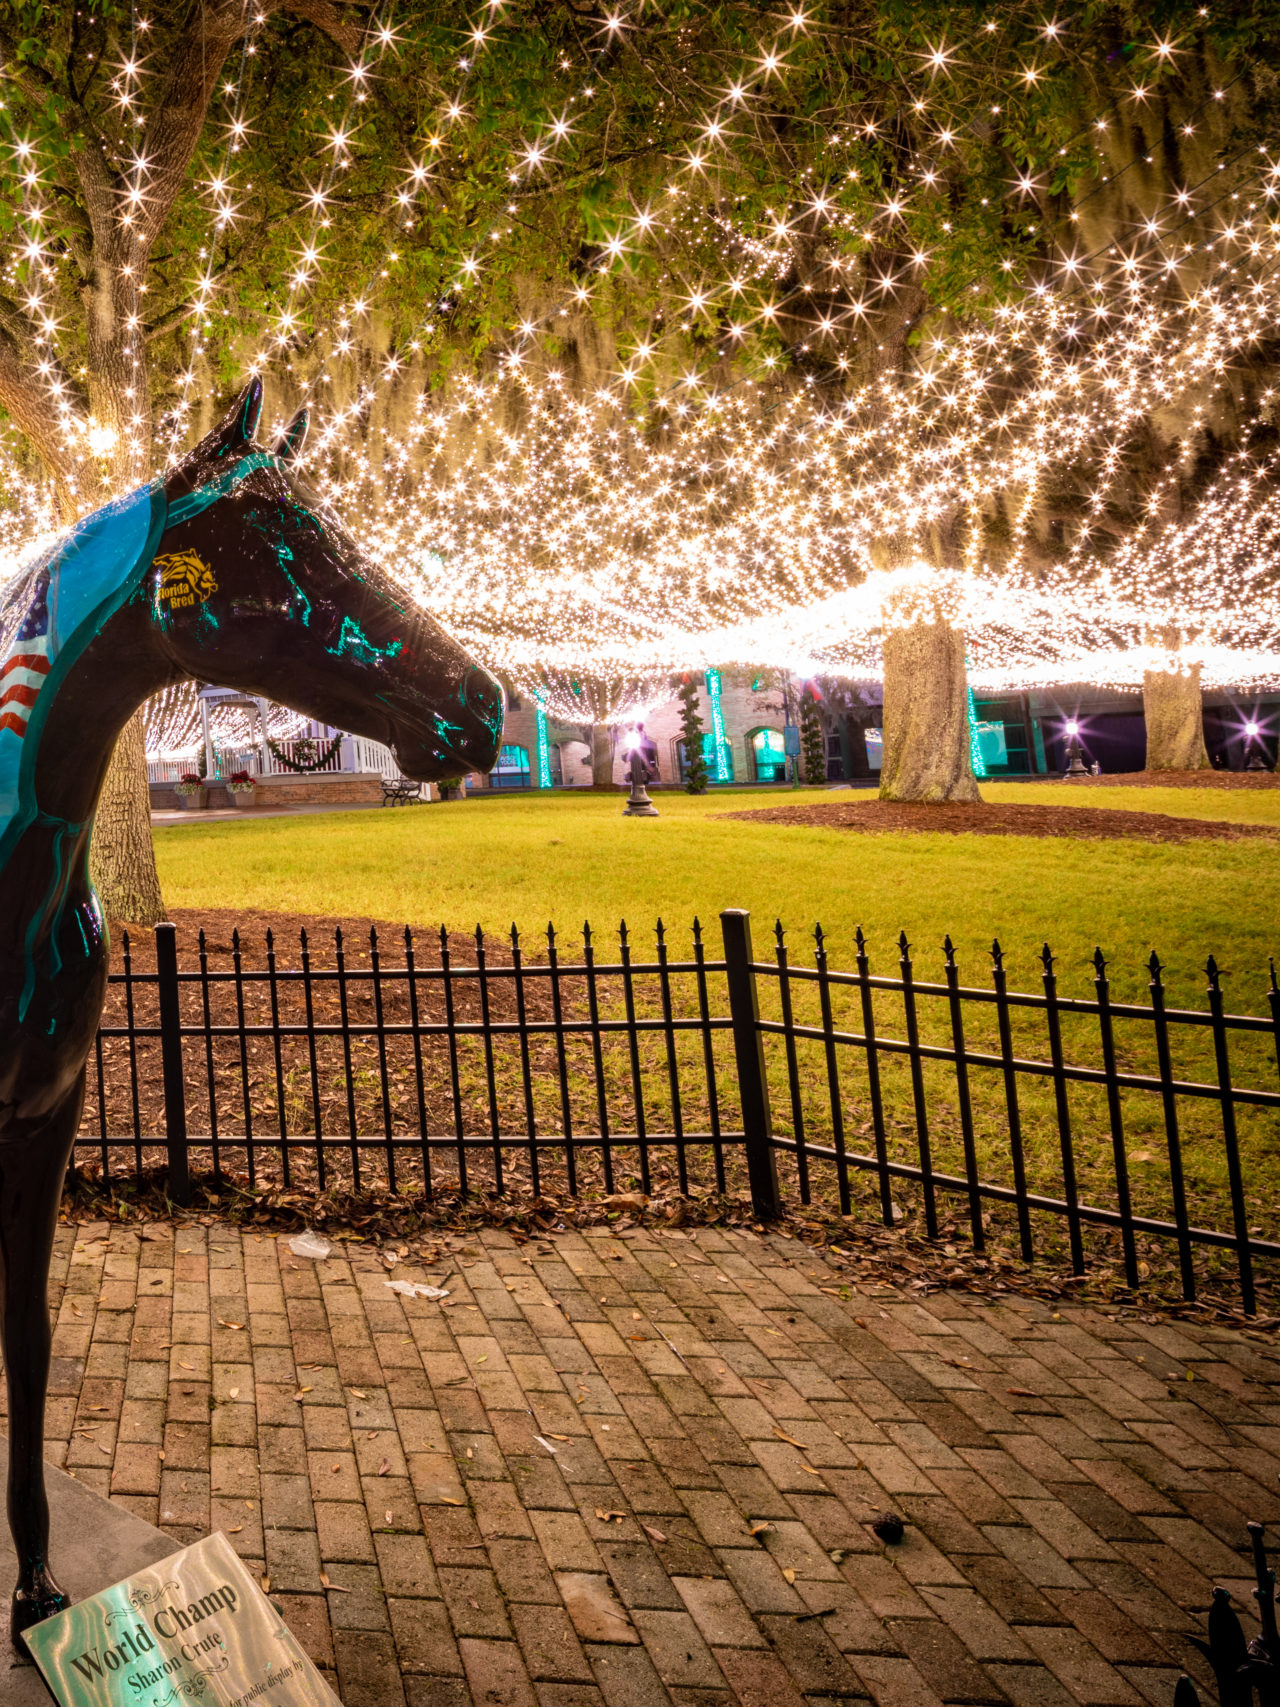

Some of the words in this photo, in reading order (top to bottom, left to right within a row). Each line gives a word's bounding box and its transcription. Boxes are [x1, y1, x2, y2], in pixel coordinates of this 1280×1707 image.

[170, 593, 195, 608] Bred
[70, 1623, 155, 1683] World
[154, 1585, 237, 1638] Champ
[127, 1655, 182, 1694] Sharon
[180, 1632, 223, 1662] Crute
[243, 1683, 267, 1706] public
[267, 1666, 294, 1687] display
[293, 1659, 304, 1671] by
